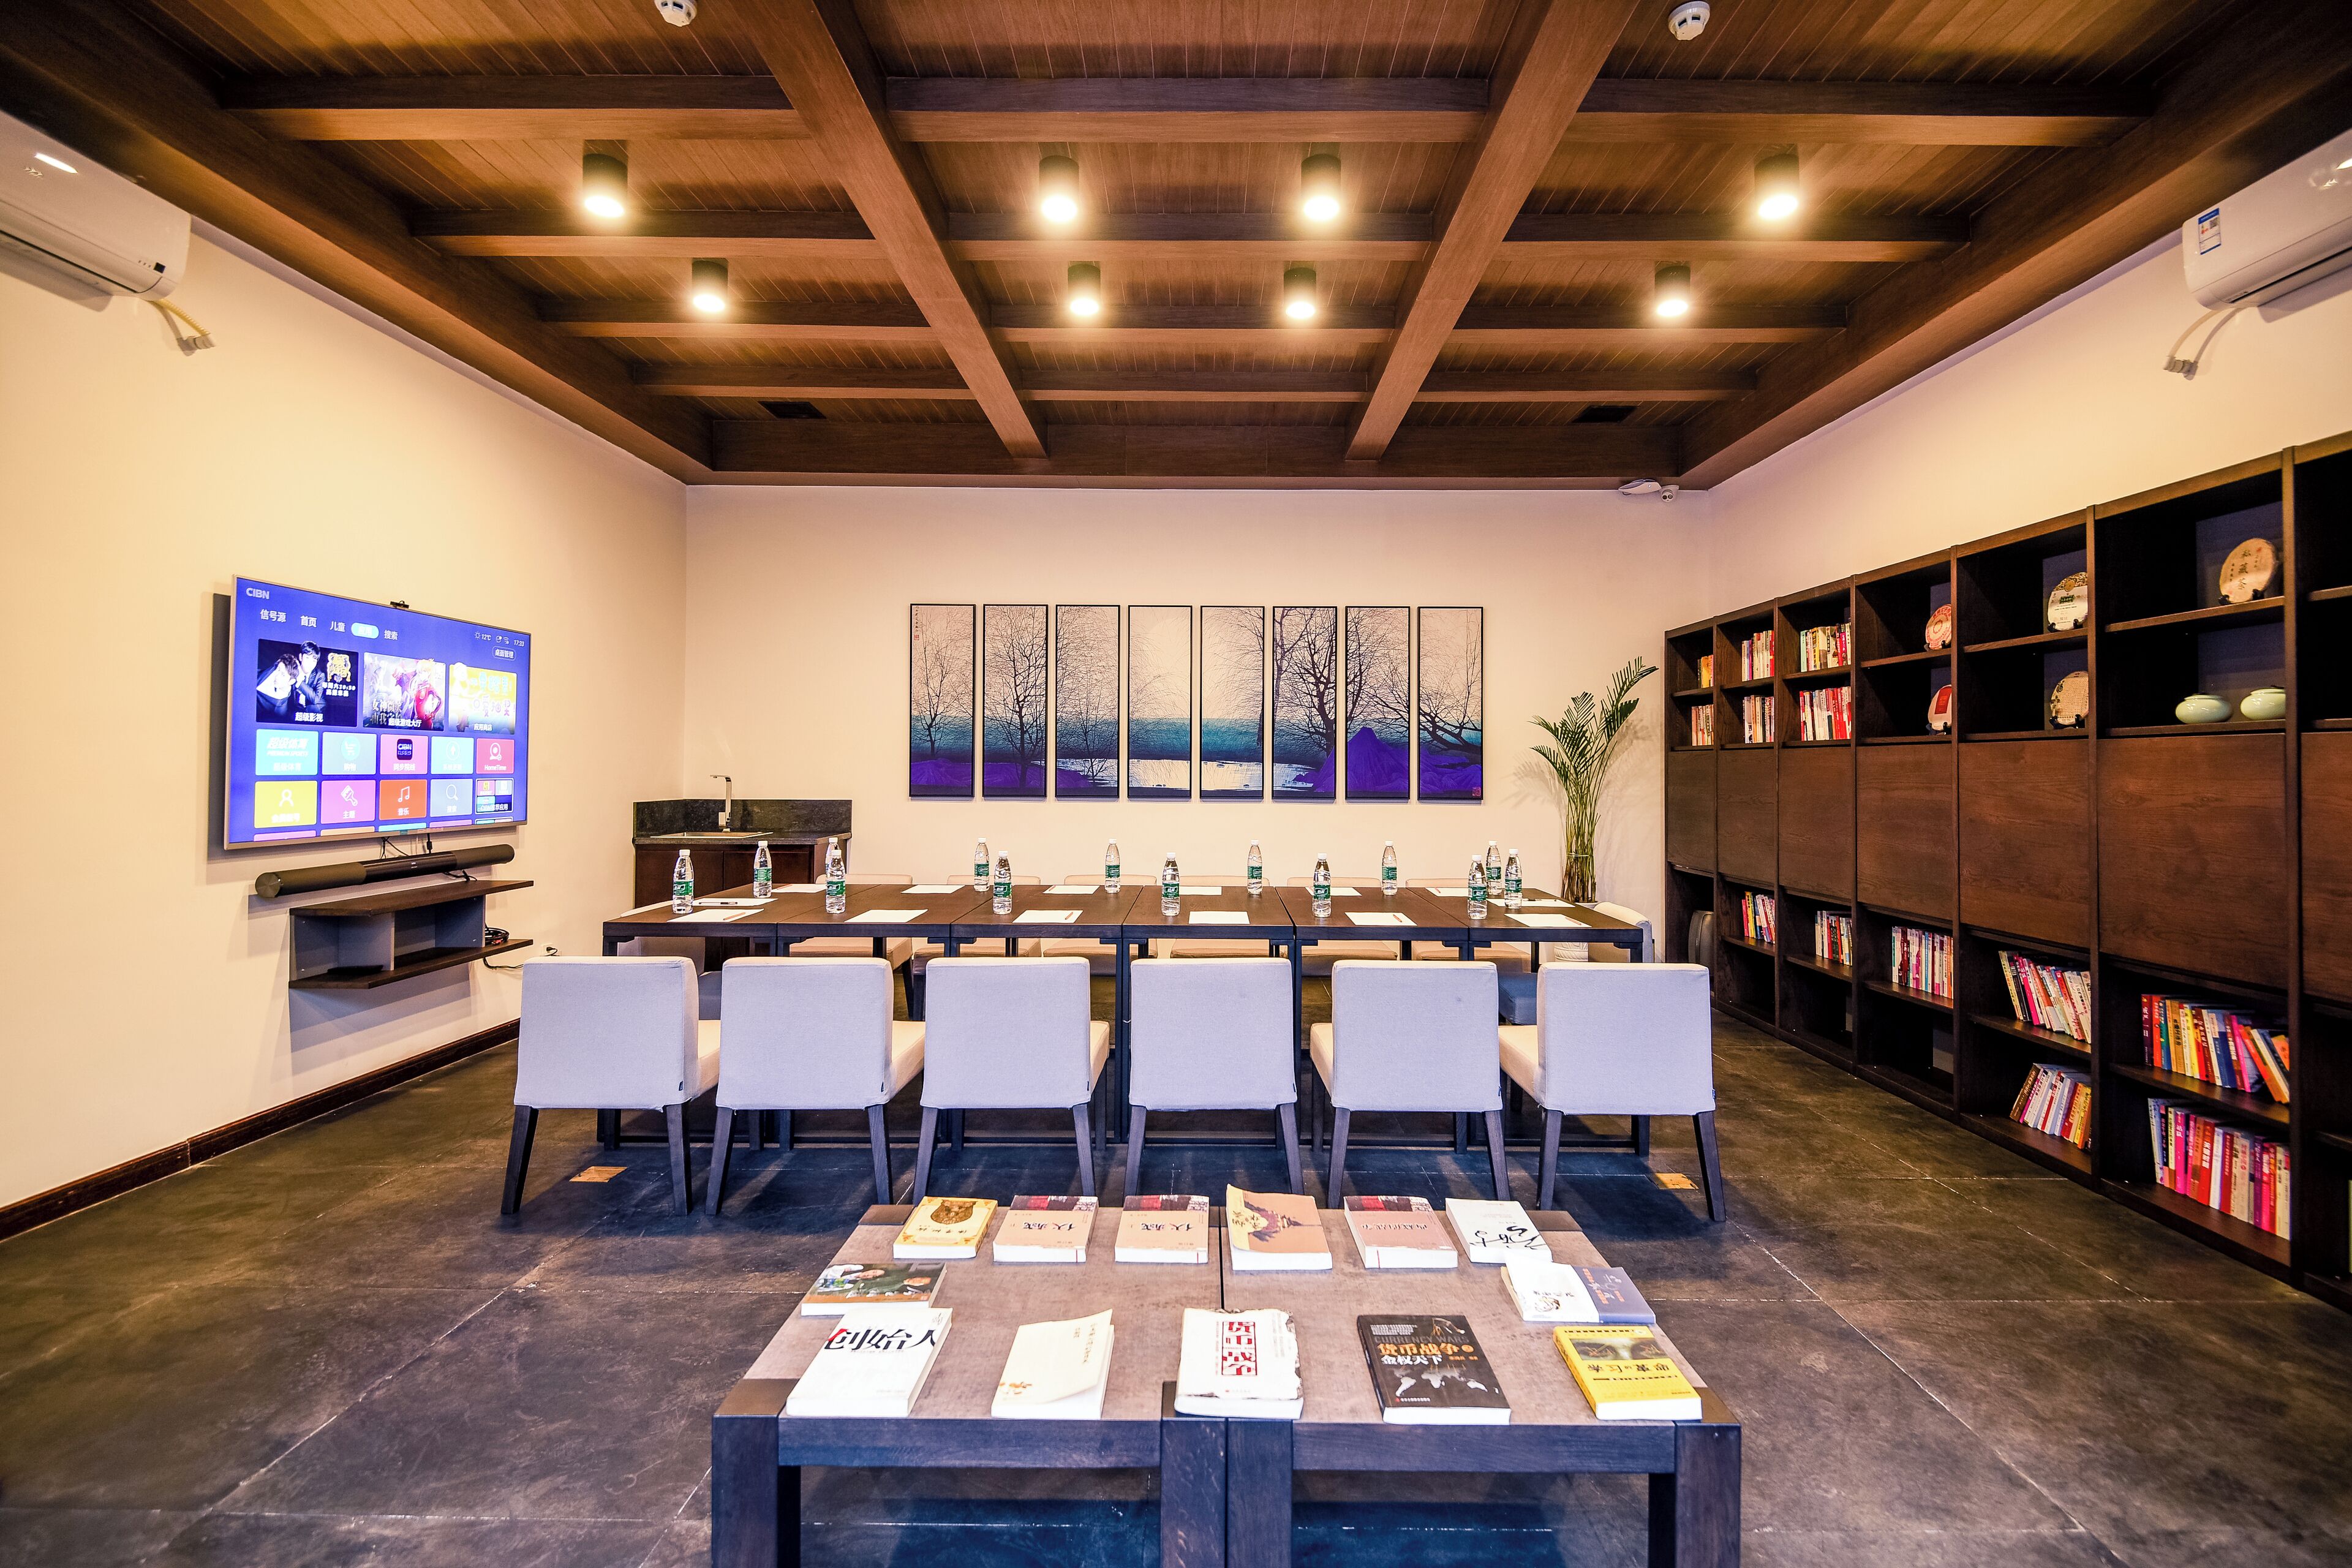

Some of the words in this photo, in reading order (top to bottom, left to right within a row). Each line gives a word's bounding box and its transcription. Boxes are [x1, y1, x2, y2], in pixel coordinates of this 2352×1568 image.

[246, 587, 270, 600] CIBN
[260, 609, 287, 623] 信号源
[300, 616, 317, 628] 首页
[330, 621, 346, 632] 儿童
[384, 630, 398, 640] 搜索
[495, 648, 514, 659] 桌面管理
[295, 712, 323, 722] 超级影视
[473, 723, 492, 731] 应用商店
[343, 810, 355, 819] 主题
[824, 1329, 936, 1351] 创始人
[1378, 1342, 1460, 1355] 货币战争
[1381, 1354, 1443, 1365] 金权天下
